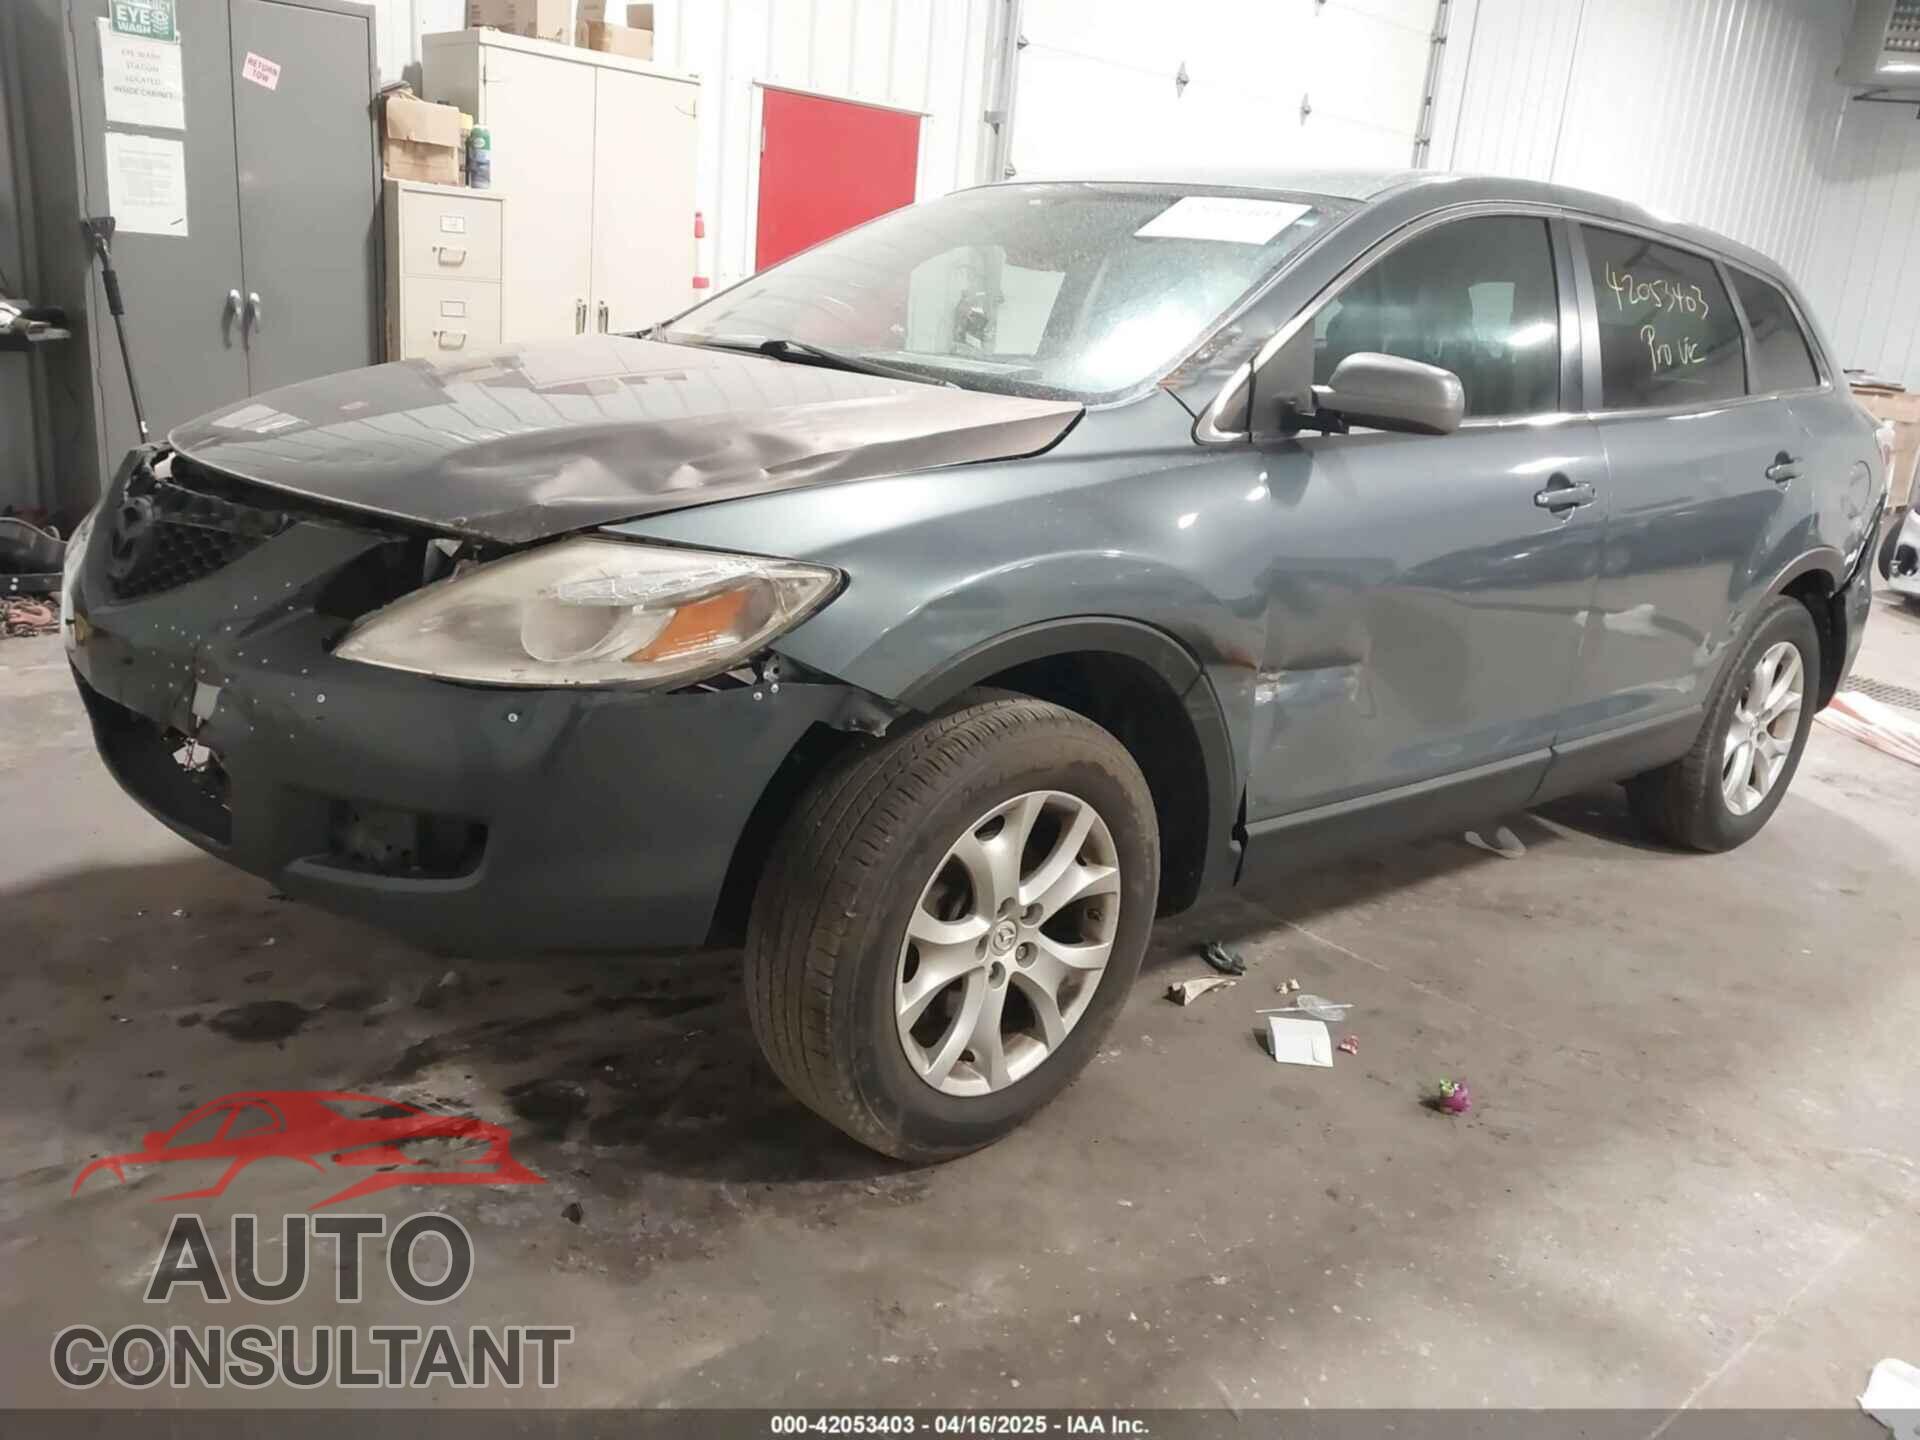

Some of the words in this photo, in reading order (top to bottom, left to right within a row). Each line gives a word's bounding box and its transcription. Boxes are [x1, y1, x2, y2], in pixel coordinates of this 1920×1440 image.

[116, 4, 150, 25] EYE
[117, 21, 152, 34] WASH
[248, 57, 278, 76] RETURN
[251, 69, 269, 82] TOW
[1606, 262, 1709, 320] 42053403
